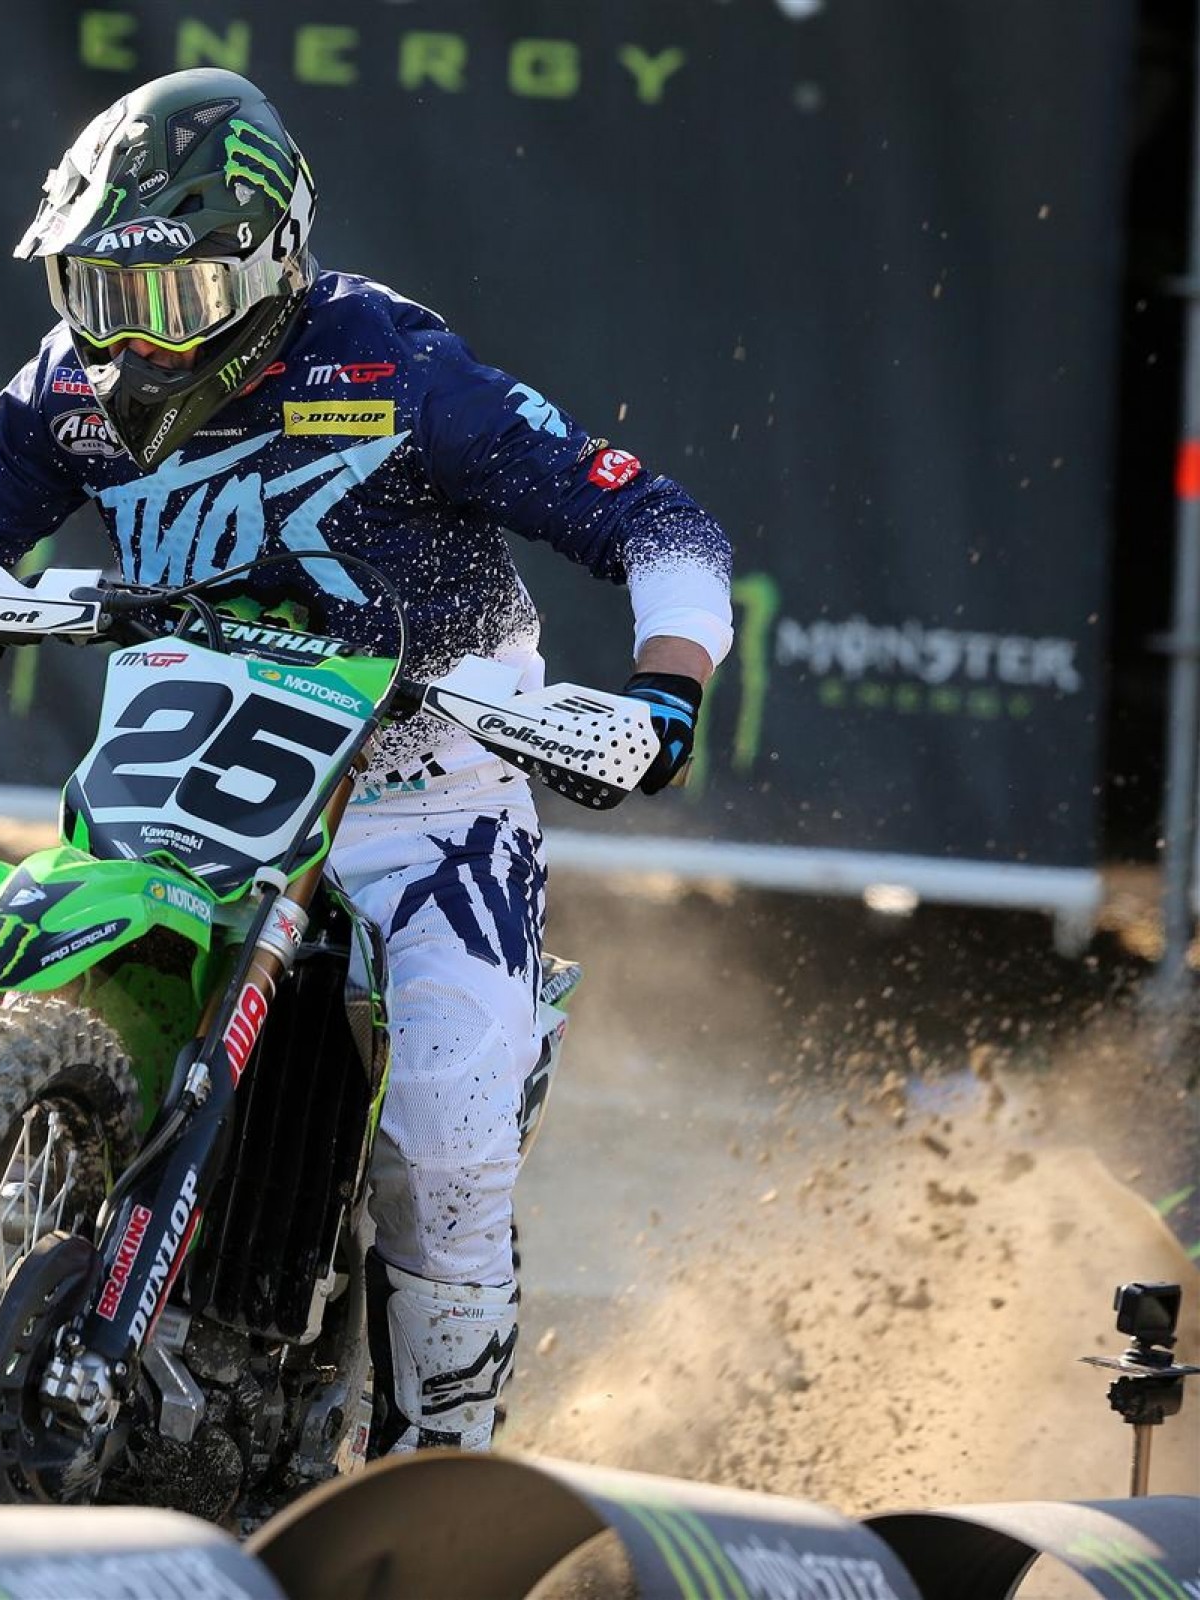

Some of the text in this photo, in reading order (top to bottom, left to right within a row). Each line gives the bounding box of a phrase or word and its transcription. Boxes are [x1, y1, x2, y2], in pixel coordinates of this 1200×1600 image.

[81, 12, 685, 102] ENERGY
[95, 221, 188, 252] Airoh
[306, 362, 396, 386] MXGP
[308, 411, 387, 424] DUNLOP
[116, 652, 189, 667] MXGP
[284, 674, 362, 712] MOTOREX
[483, 718, 596, 762] Polisport
[83, 680, 353, 838] 25
[140, 825, 204, 850] Kawasaki
[166, 884, 211, 920] MOTOREX
[41, 945, 70, 966] PRO
[98, 1204, 152, 1320] BRAKING
[128, 1167, 198, 1351] DUNLOP
